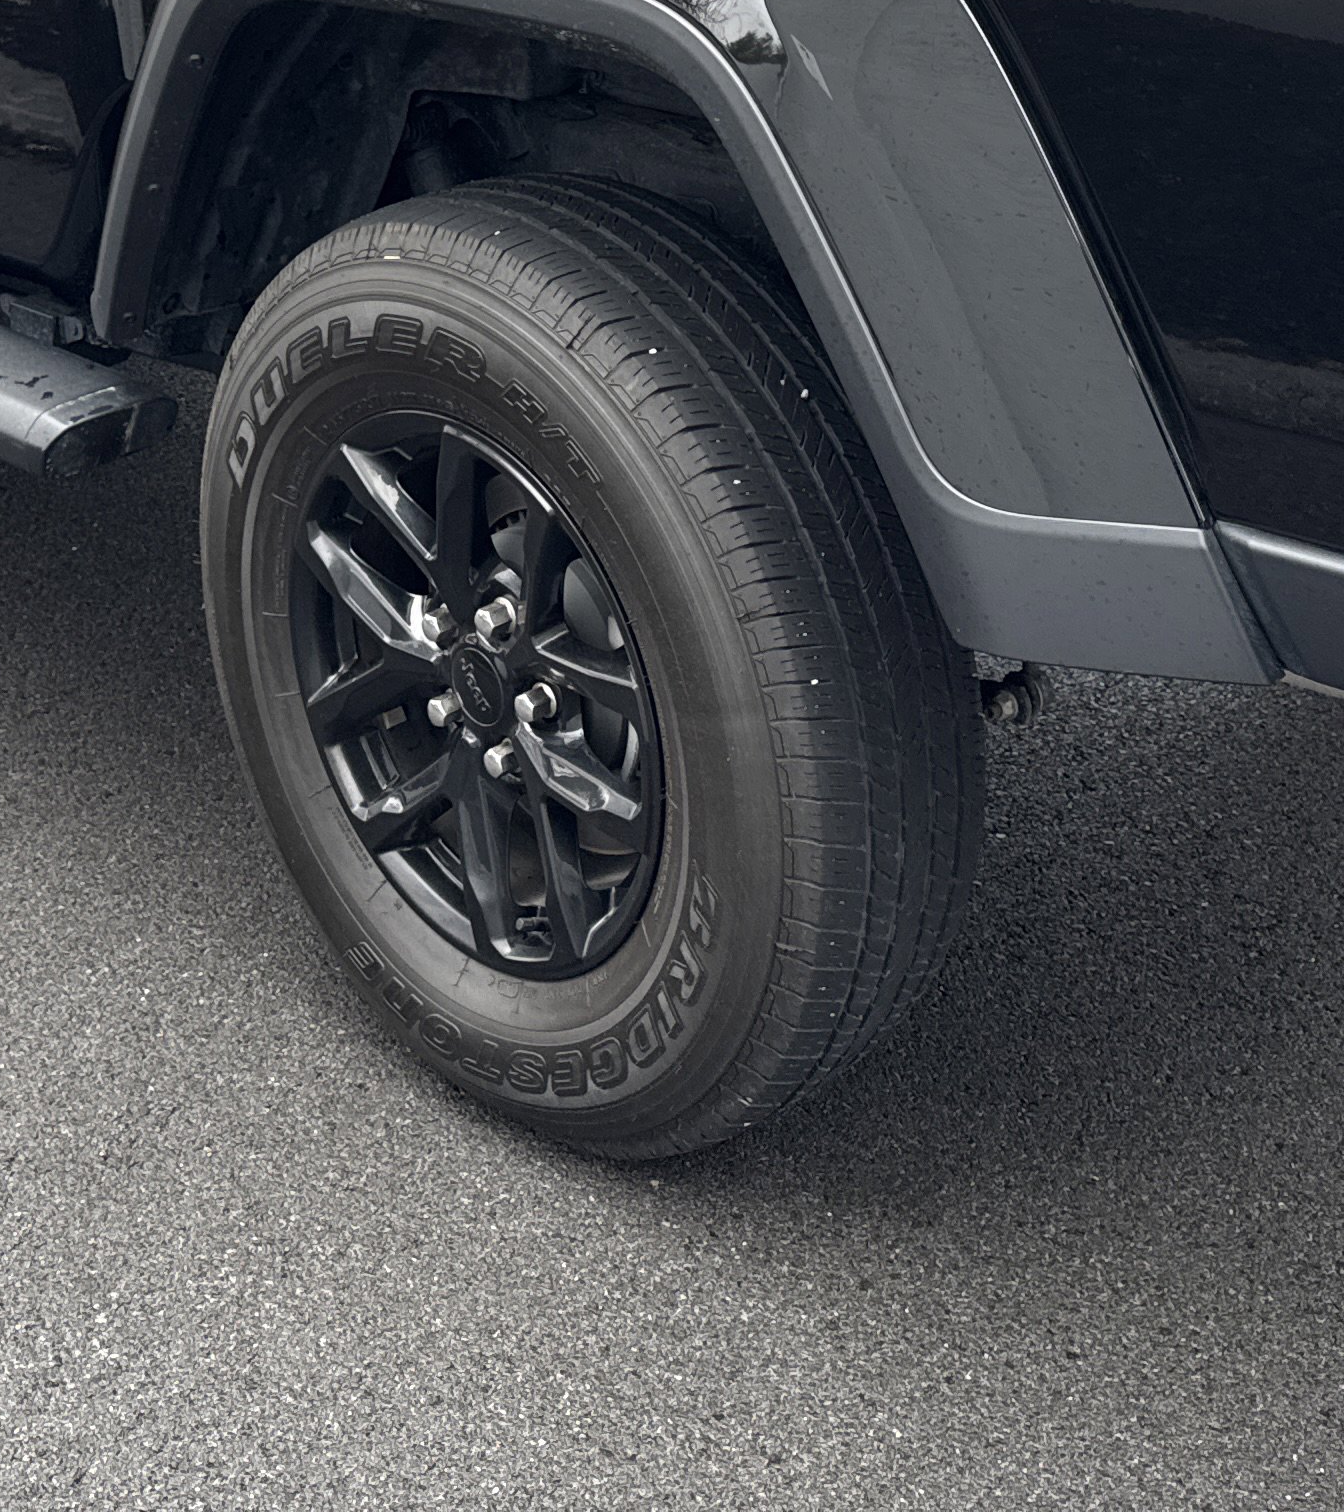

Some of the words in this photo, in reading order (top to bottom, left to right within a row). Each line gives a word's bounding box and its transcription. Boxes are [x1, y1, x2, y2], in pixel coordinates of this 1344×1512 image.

[225, 312, 488, 489] DUELER
[502, 377, 604, 485] H/T
[459, 656, 492, 712] Jeep
[345, 857, 722, 1098] BRIDGESTONE
